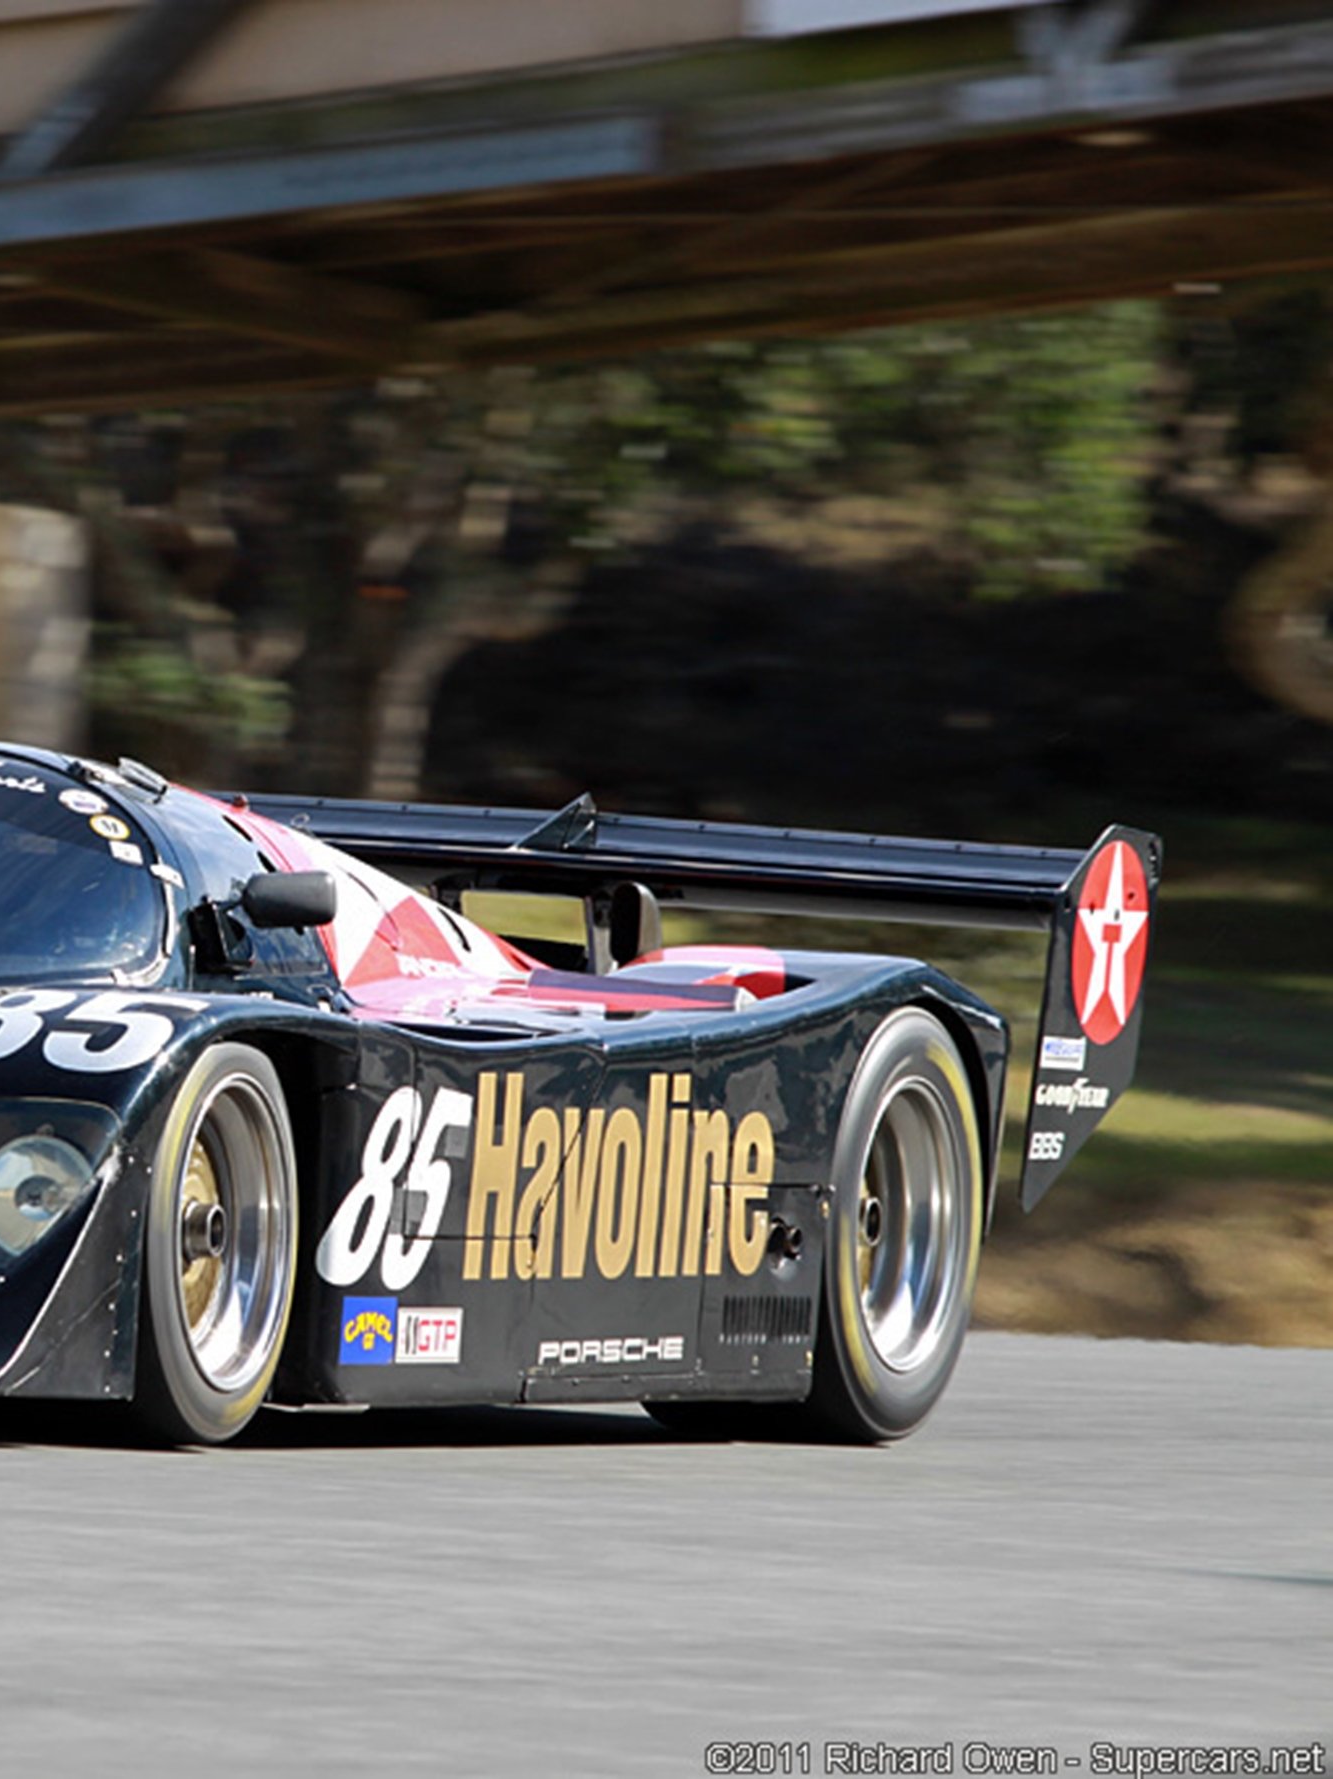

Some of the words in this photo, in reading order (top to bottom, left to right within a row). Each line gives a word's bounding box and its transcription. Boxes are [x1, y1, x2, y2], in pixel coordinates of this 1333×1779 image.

[1028, 1131, 1065, 1160] BBS
[314, 1085, 474, 1290] 85
[462, 1071, 775, 1281] Havoline
[417, 1319, 457, 1352] GTP
[537, 1336, 685, 1365] PORSCHE
